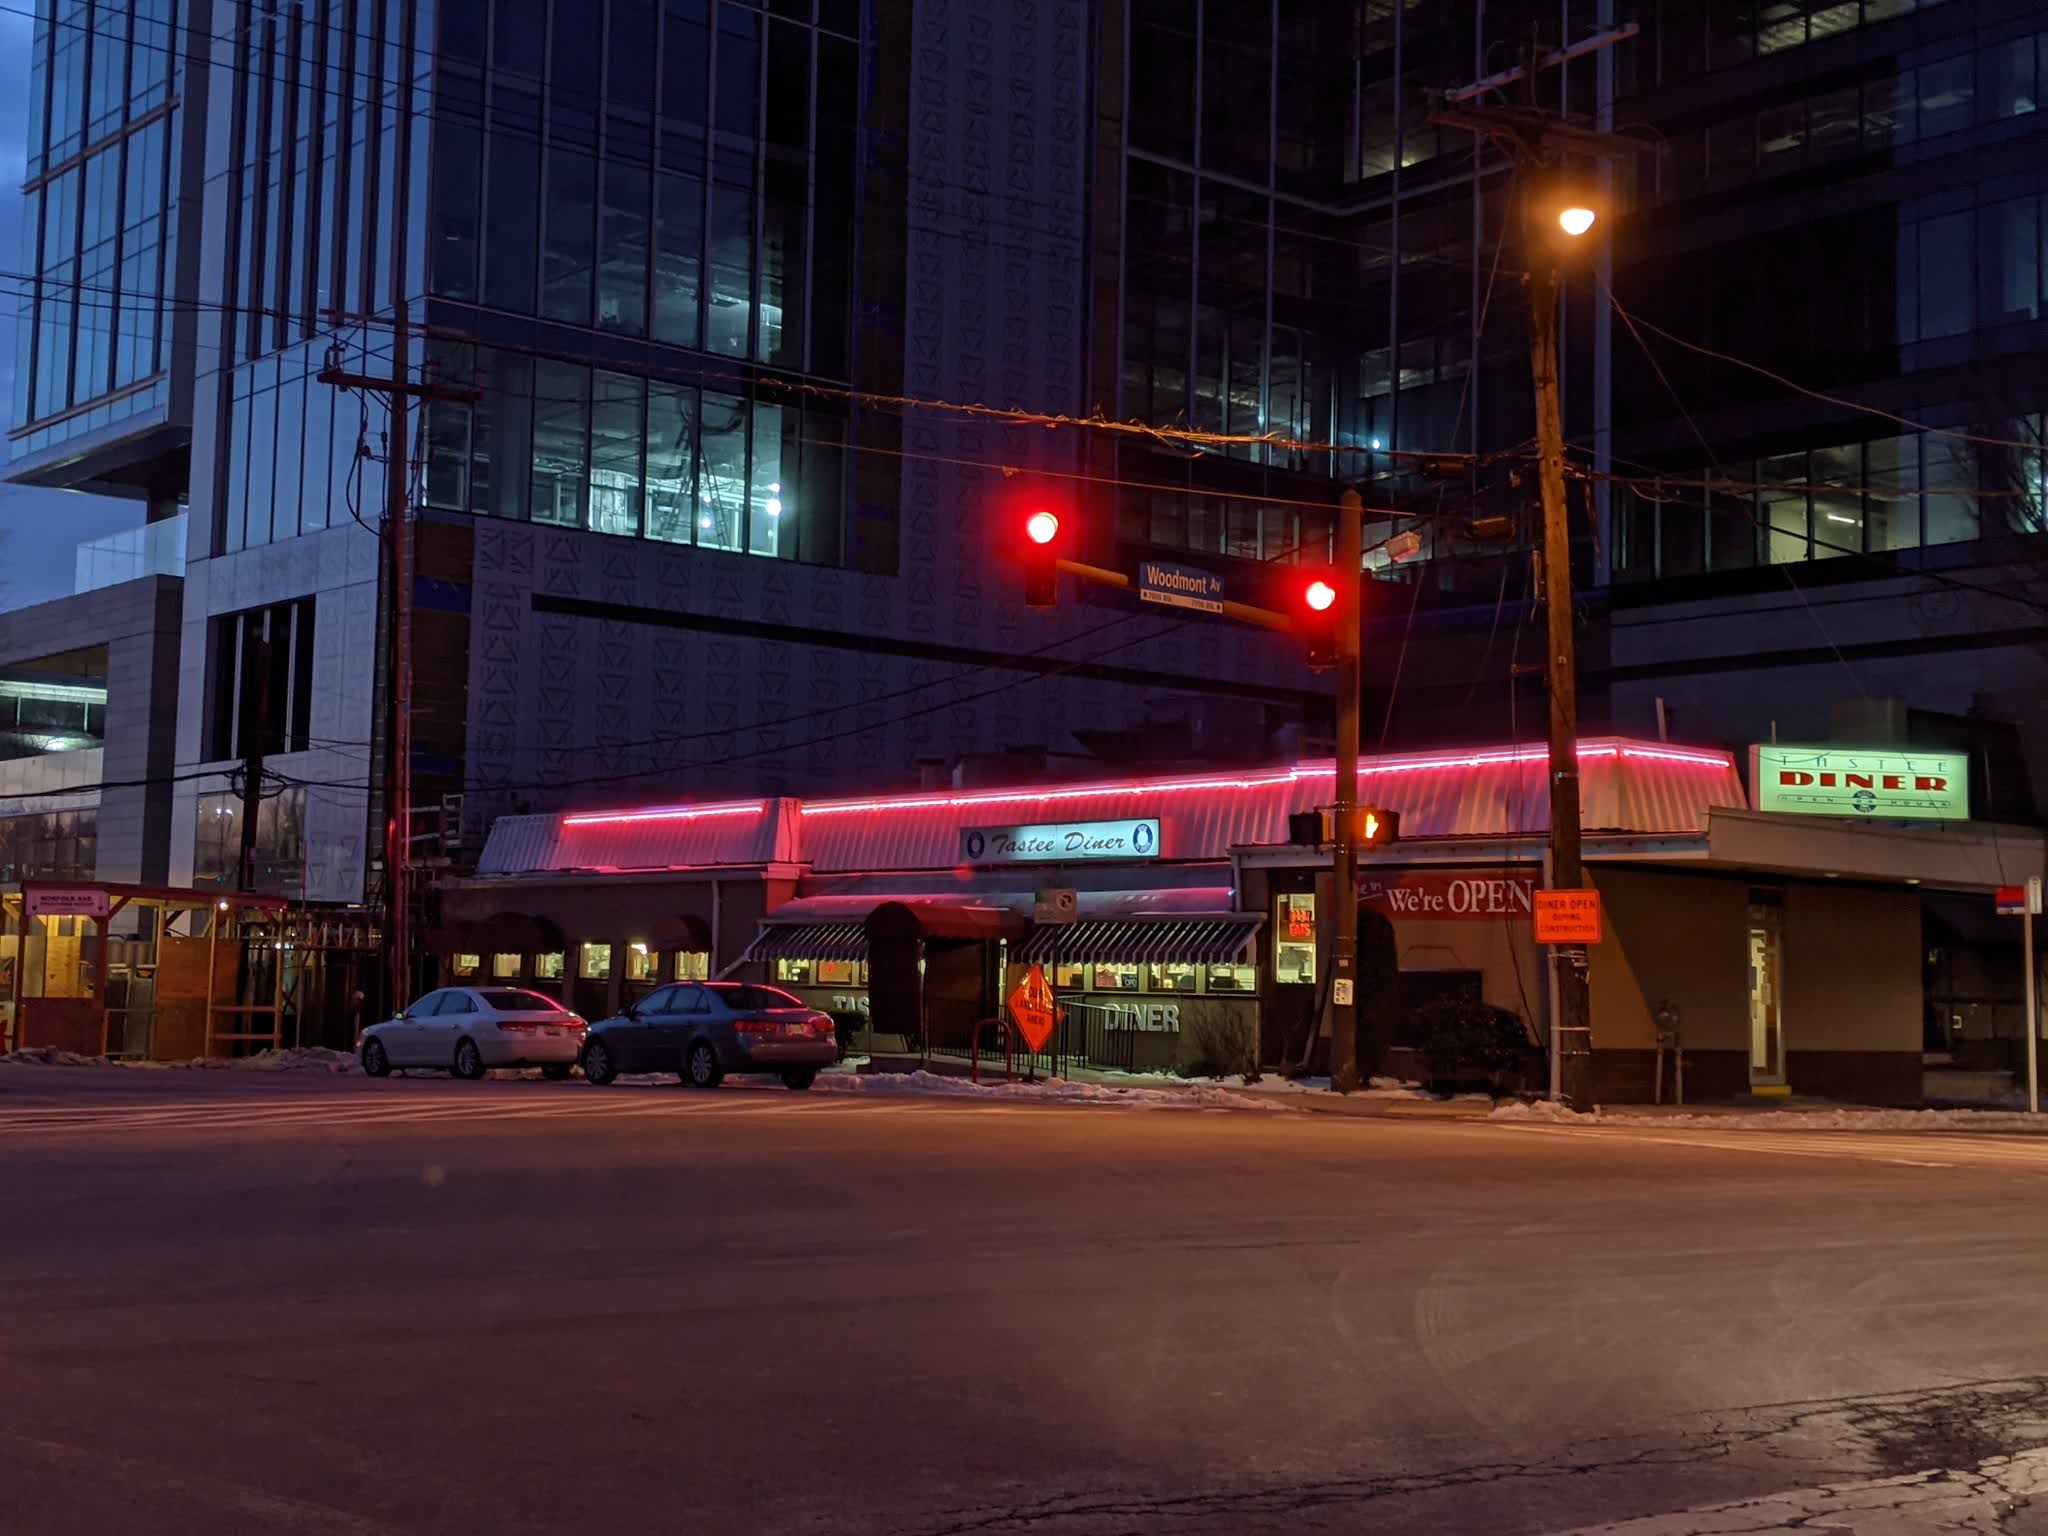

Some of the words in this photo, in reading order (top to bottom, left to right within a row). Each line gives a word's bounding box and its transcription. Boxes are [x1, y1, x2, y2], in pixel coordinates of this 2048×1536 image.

[1147, 565, 1207, 594] Woodmont
[1210, 577, 1222, 592] Av
[1780, 755, 1948, 773] TASTEE
[1779, 771, 1948, 792] DINER
[992, 833, 1055, 854] Tastee
[1064, 831, 1126, 852] Diner
[1387, 887, 1443, 912] We're
[1447, 880, 1534, 913] OPEN
[1538, 899, 1566, 909] DINER
[1570, 899, 1595, 909] OPEN
[1104, 1003, 1179, 1033] DINER
